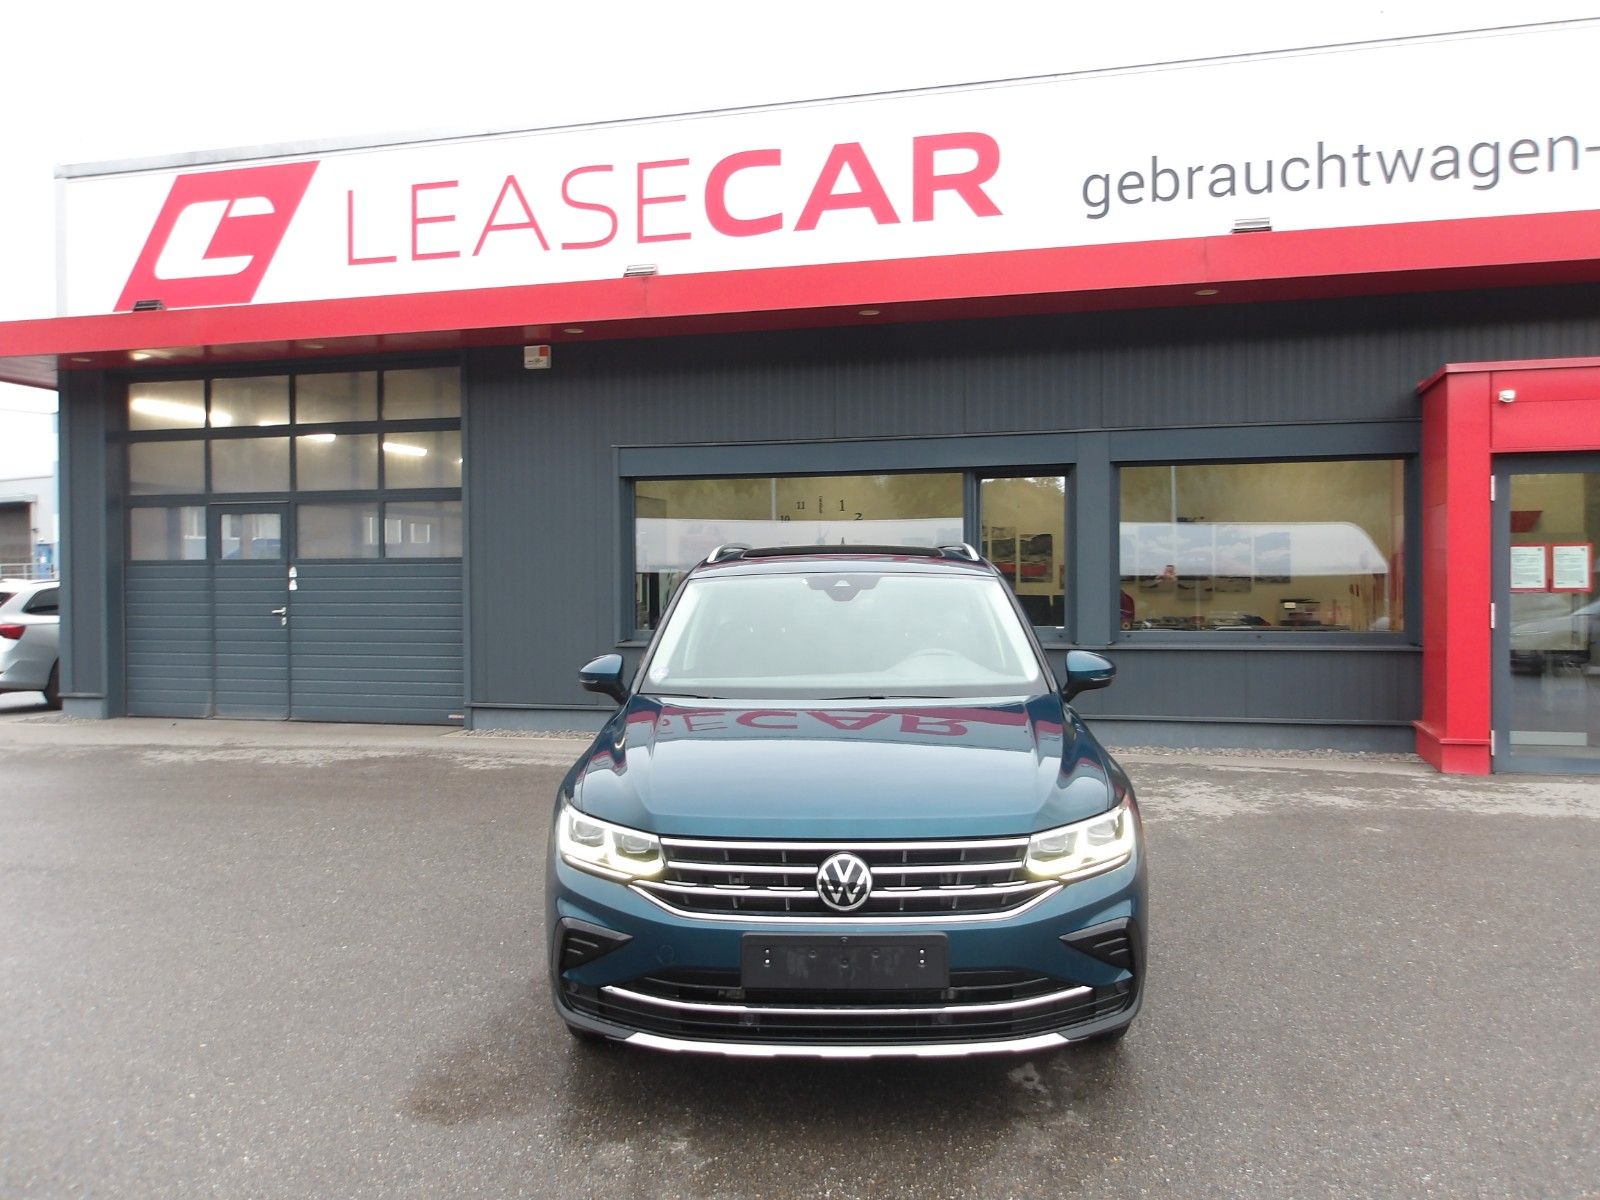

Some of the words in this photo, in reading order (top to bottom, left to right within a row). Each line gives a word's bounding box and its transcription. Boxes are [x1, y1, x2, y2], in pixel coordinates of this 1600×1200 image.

[347, 131, 1002, 267] LEASECAR
[839, 499, 845, 512] 1
[854, 512, 863, 521] 2
